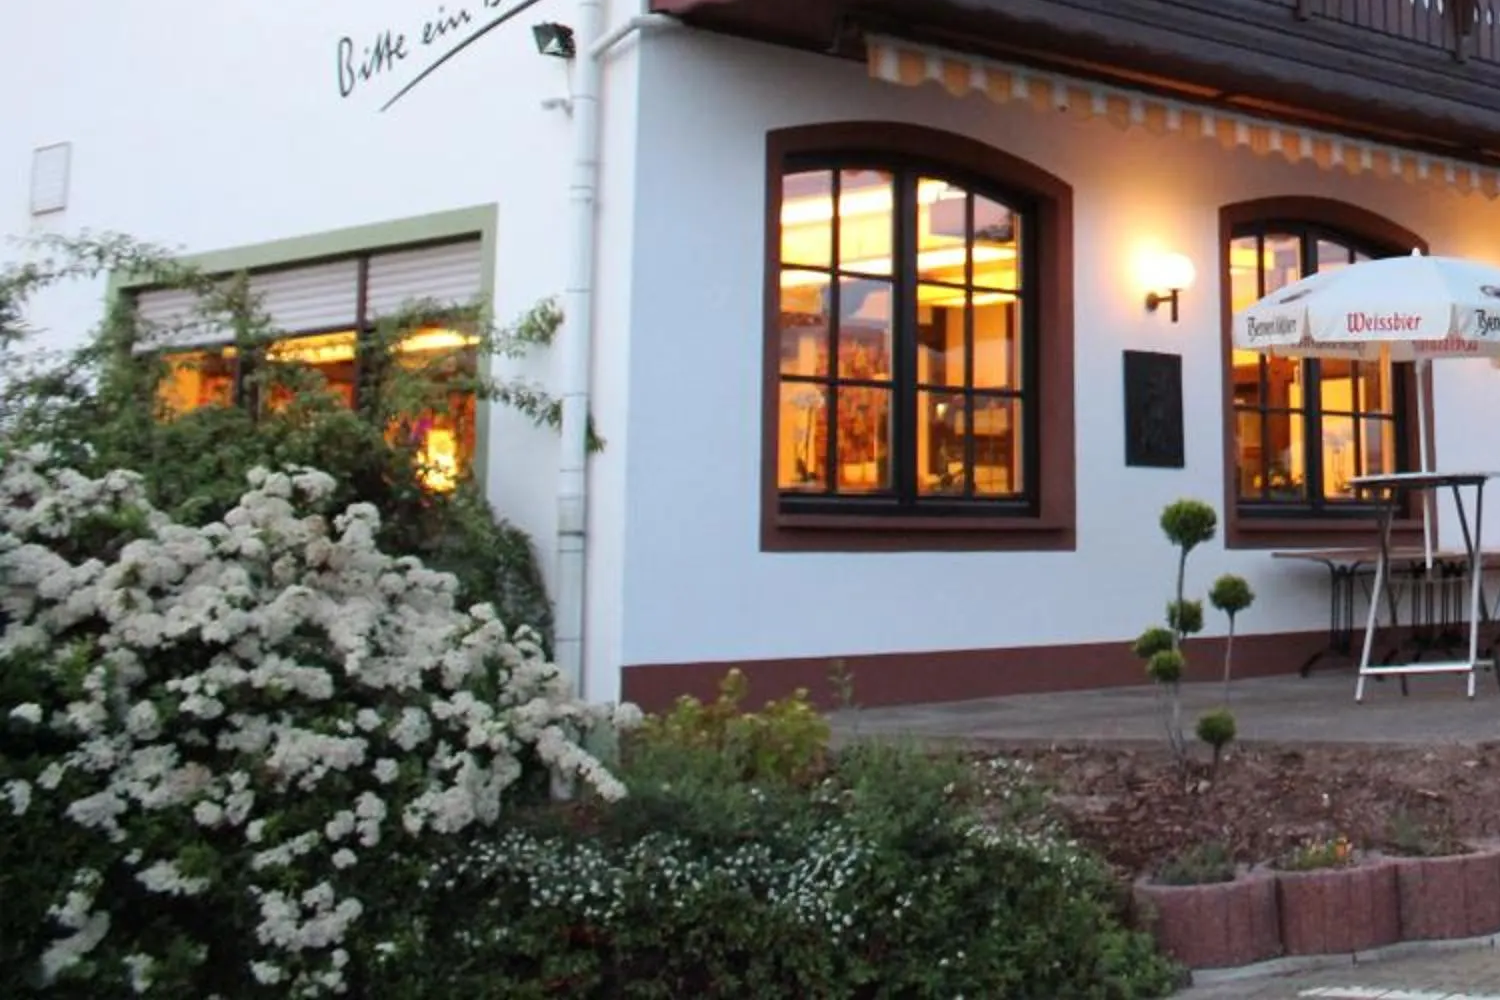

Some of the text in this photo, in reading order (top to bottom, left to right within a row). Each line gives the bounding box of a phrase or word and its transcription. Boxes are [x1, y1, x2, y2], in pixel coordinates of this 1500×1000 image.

[336, 32, 406, 99] Bitte
[421, 5, 471, 48] ein
[1346, 311, 1422, 333] Weissbier
